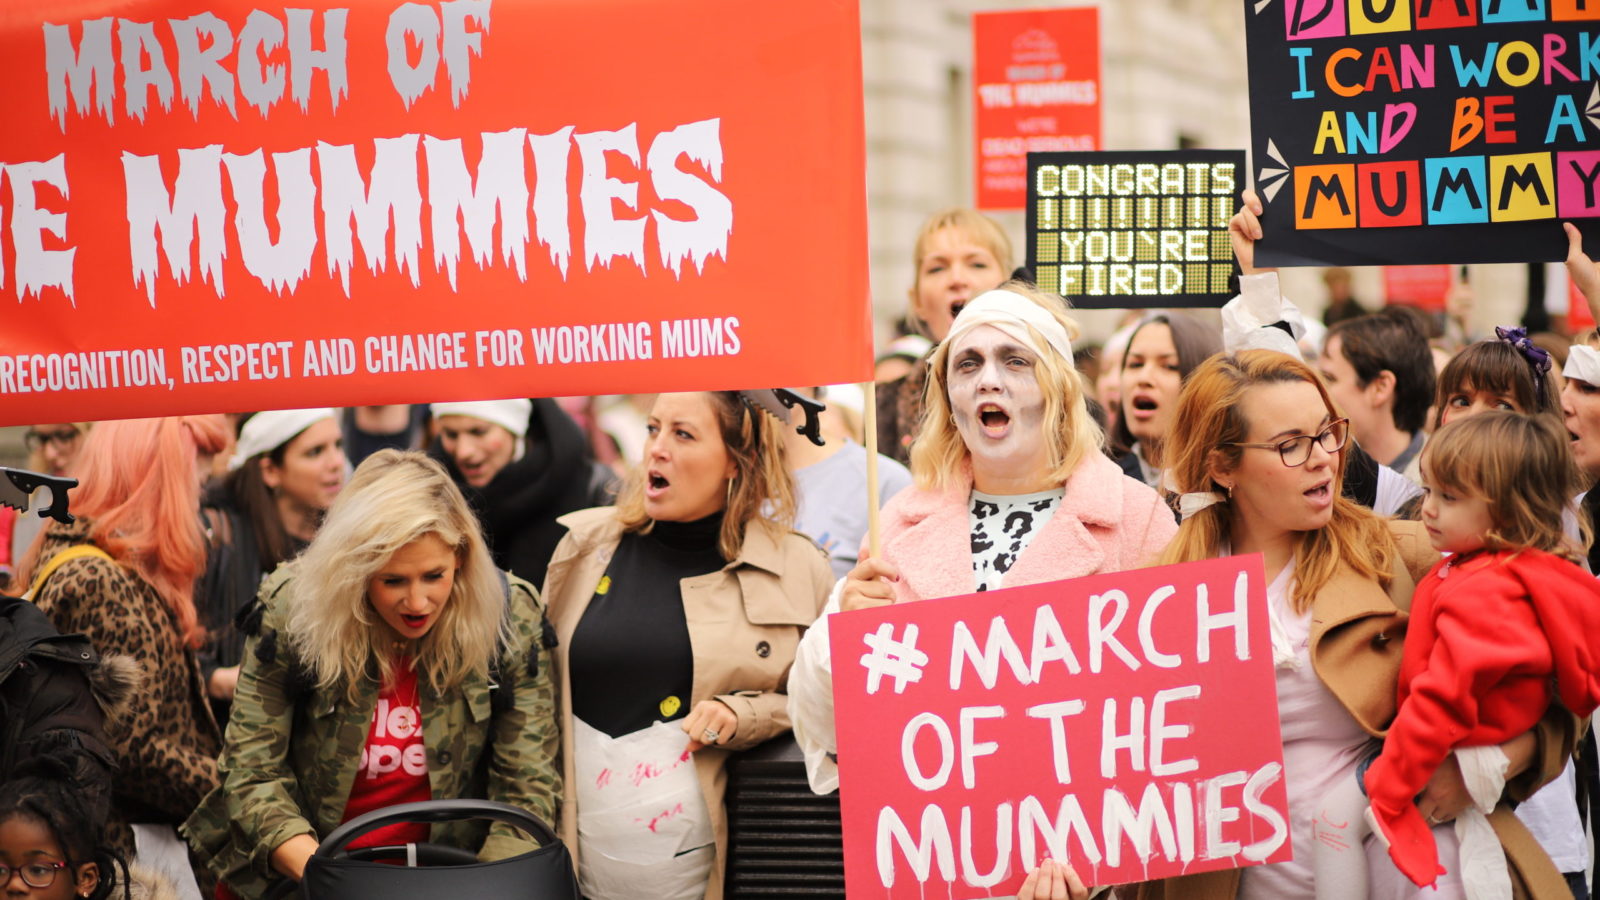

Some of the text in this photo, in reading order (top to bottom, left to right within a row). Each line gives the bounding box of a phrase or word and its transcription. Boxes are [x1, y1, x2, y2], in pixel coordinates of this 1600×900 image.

[43, 0, 493, 135] MARCH OF
[1289, 32, 1600, 99] I CAN WORK
[1313, 95, 1586, 154] AND BE A
[0, 118, 733, 310] E MUMMIES
[1037, 163, 1235, 196] CONGRATS
[1302, 159, 1600, 220] MUMMY
[1060, 264, 1183, 296] FIRED
[0, 316, 741, 393] RECOGNITION, RESPECT AND CHANGE FOR WORKING MUMS
[901, 685, 1201, 791] OF THE
[876, 762, 1288, 889] MUMMIES
